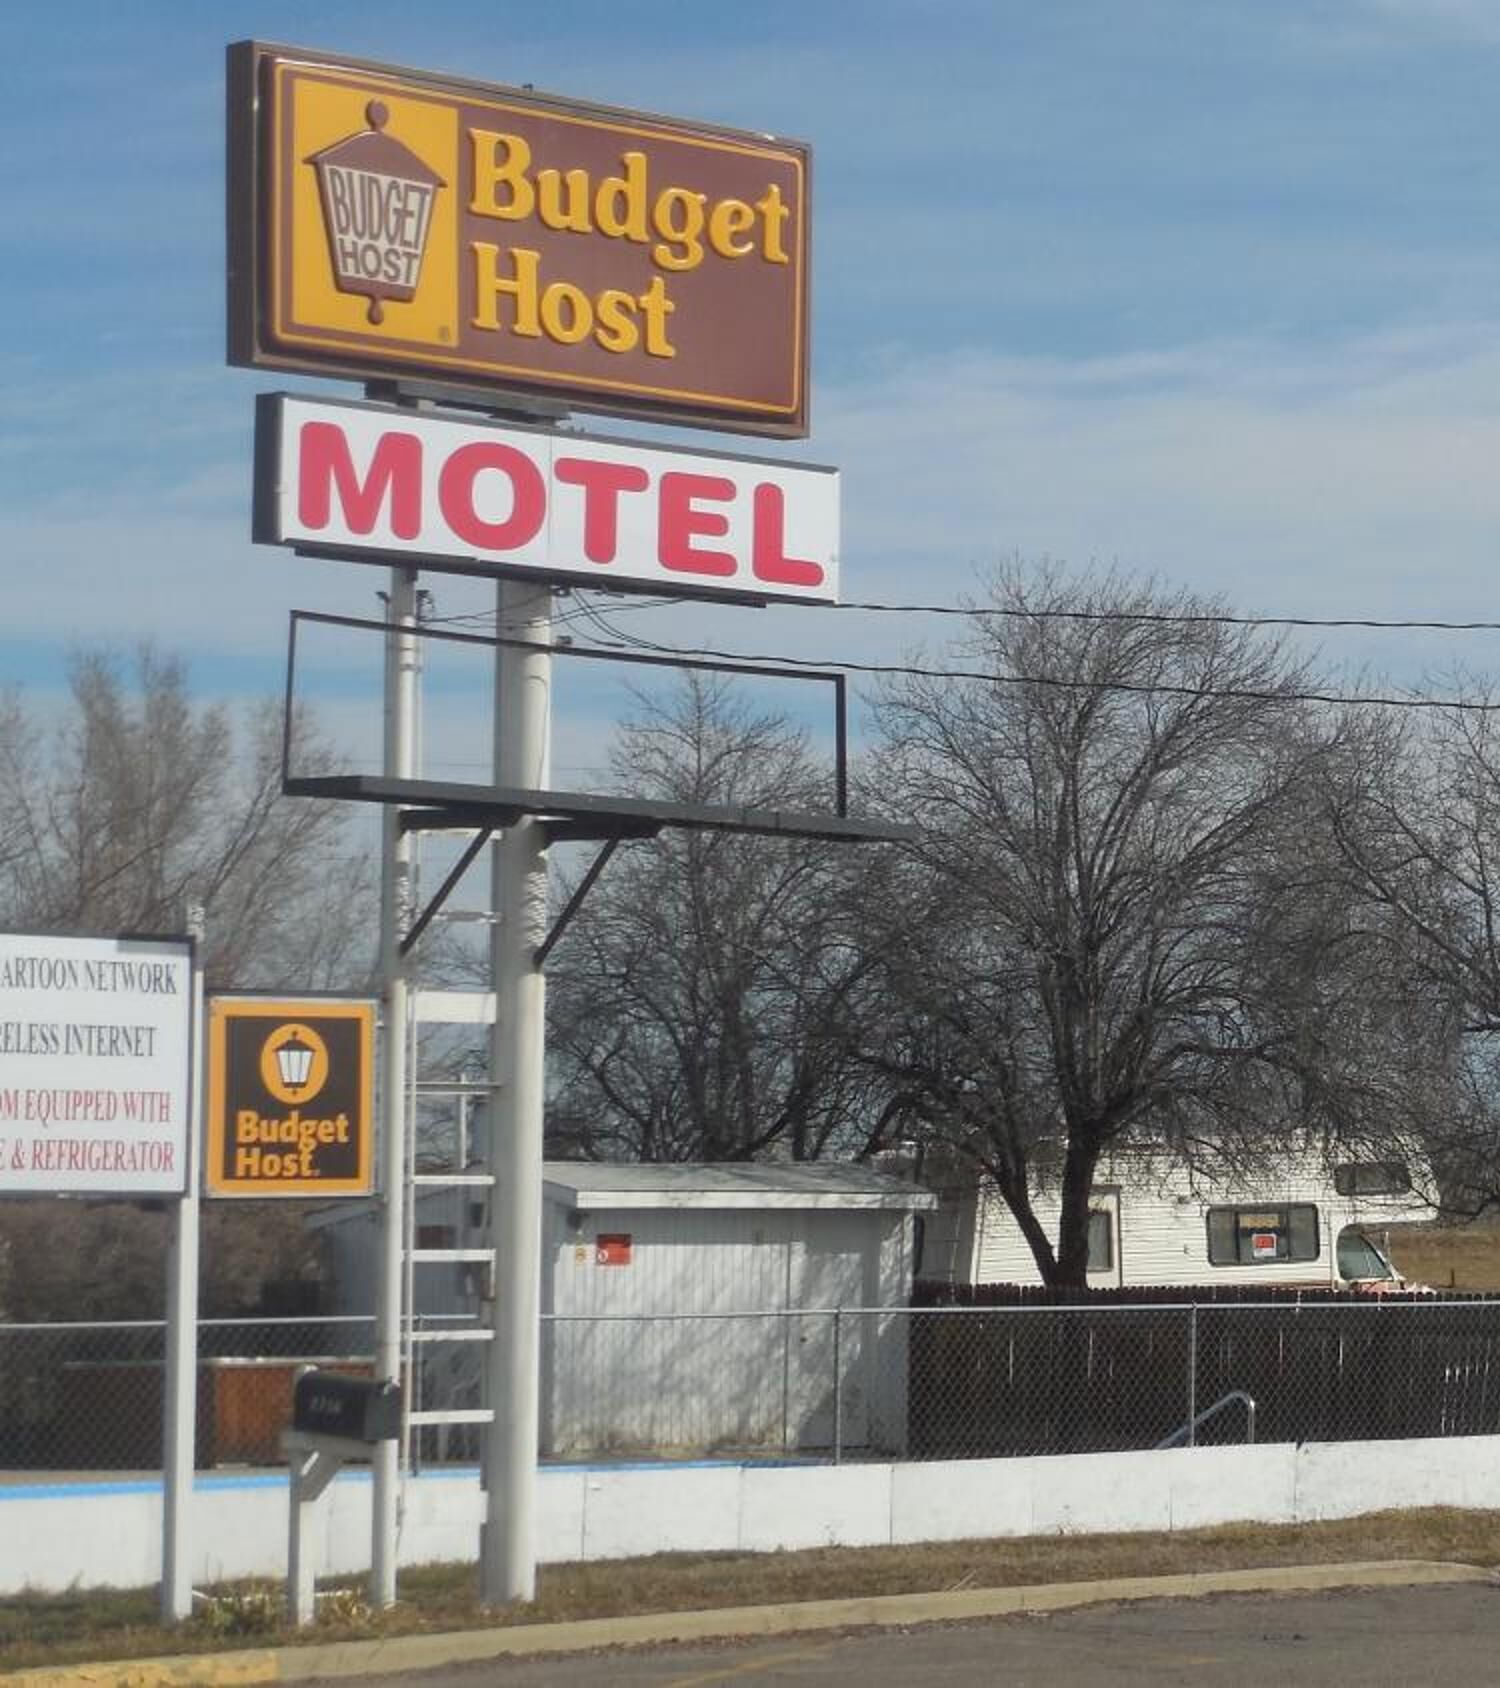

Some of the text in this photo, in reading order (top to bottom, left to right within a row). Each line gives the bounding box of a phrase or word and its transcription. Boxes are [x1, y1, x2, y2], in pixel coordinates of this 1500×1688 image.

[328, 166, 431, 250] BUDGET
[469, 128, 790, 272] Budget
[338, 237, 419, 284] HOST
[472, 241, 676, 359] Host
[299, 421, 825, 588] MOTEL
[84, 960, 177, 994] NETWORK
[64, 1023, 157, 1057] INTERNET
[24, 1088, 117, 1128] EQUIPPED
[123, 1091, 171, 1123] WITH
[236, 1109, 349, 1153] Budget
[11, 1137, 25, 1170] &
[31, 1138, 175, 1173] REFRIGERATOR
[236, 1146, 314, 1177] Host
